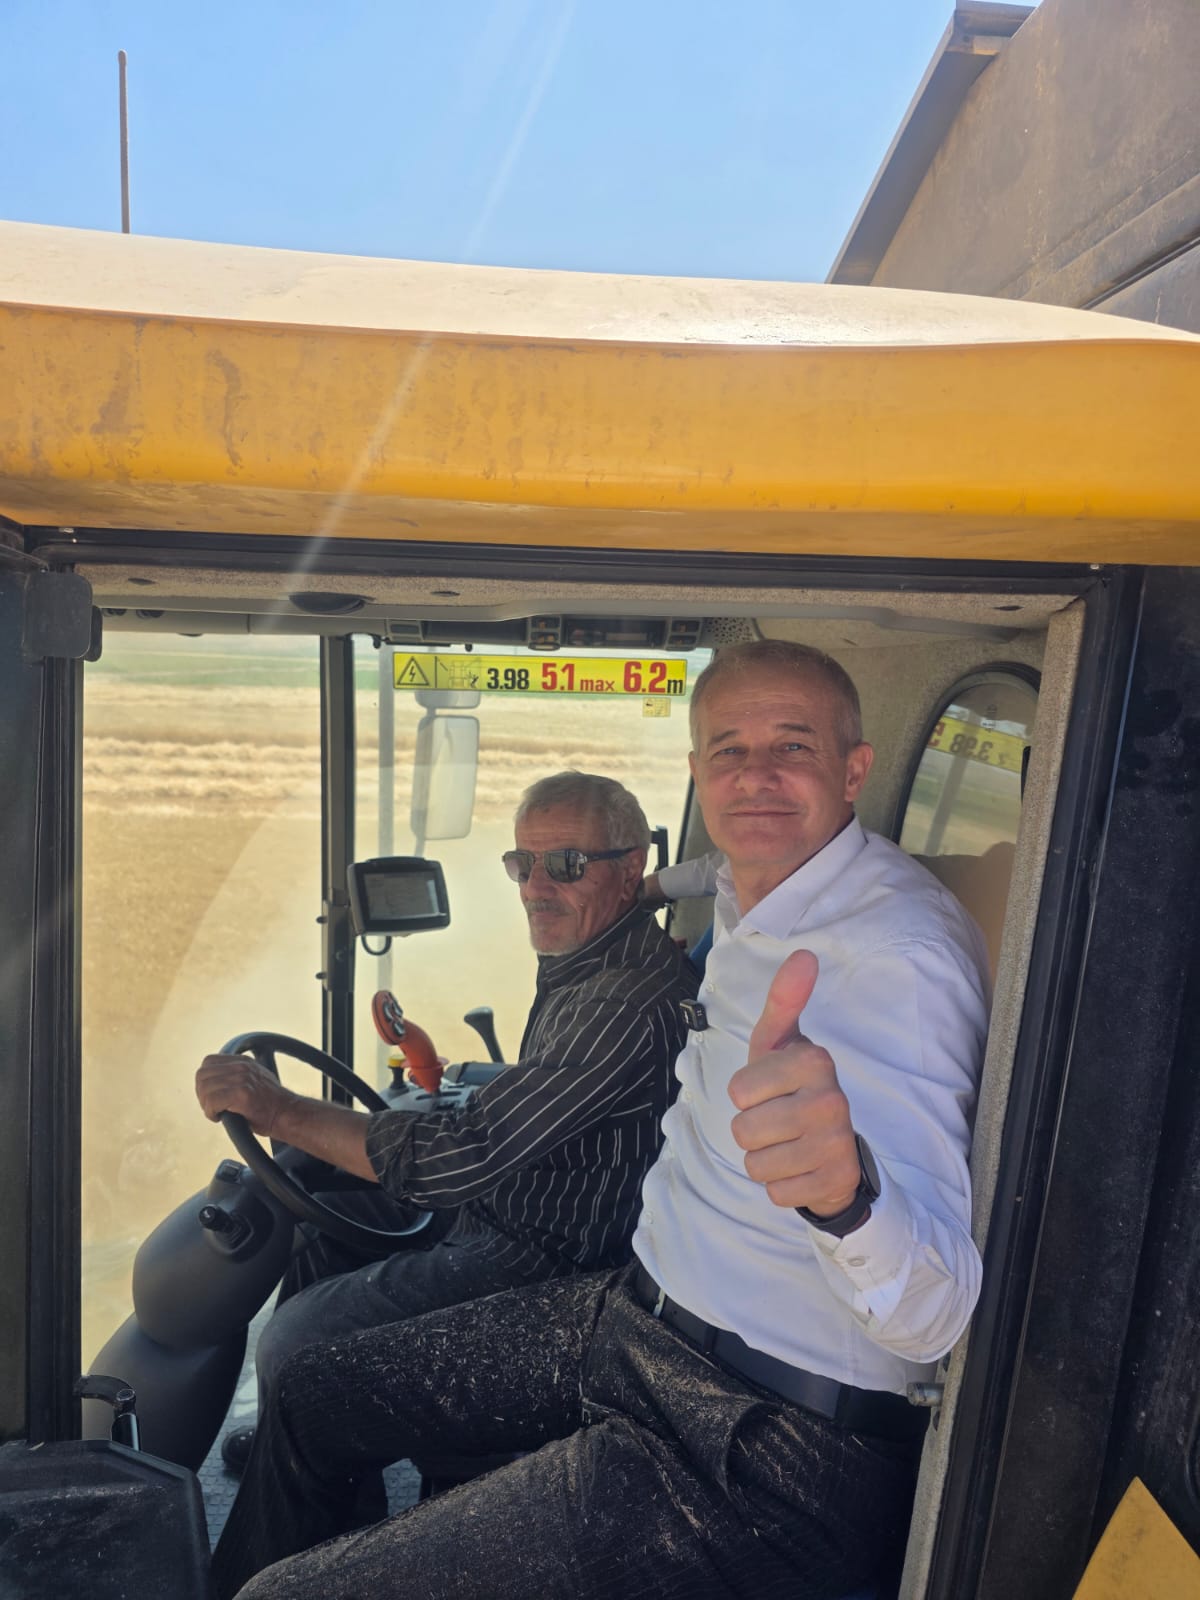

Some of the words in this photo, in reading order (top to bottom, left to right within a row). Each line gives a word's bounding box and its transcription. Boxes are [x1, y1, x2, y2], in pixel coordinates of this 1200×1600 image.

[487, 667, 530, 691] 3.98
[541, 662, 575, 692] 5.1
[580, 678, 615, 692] max
